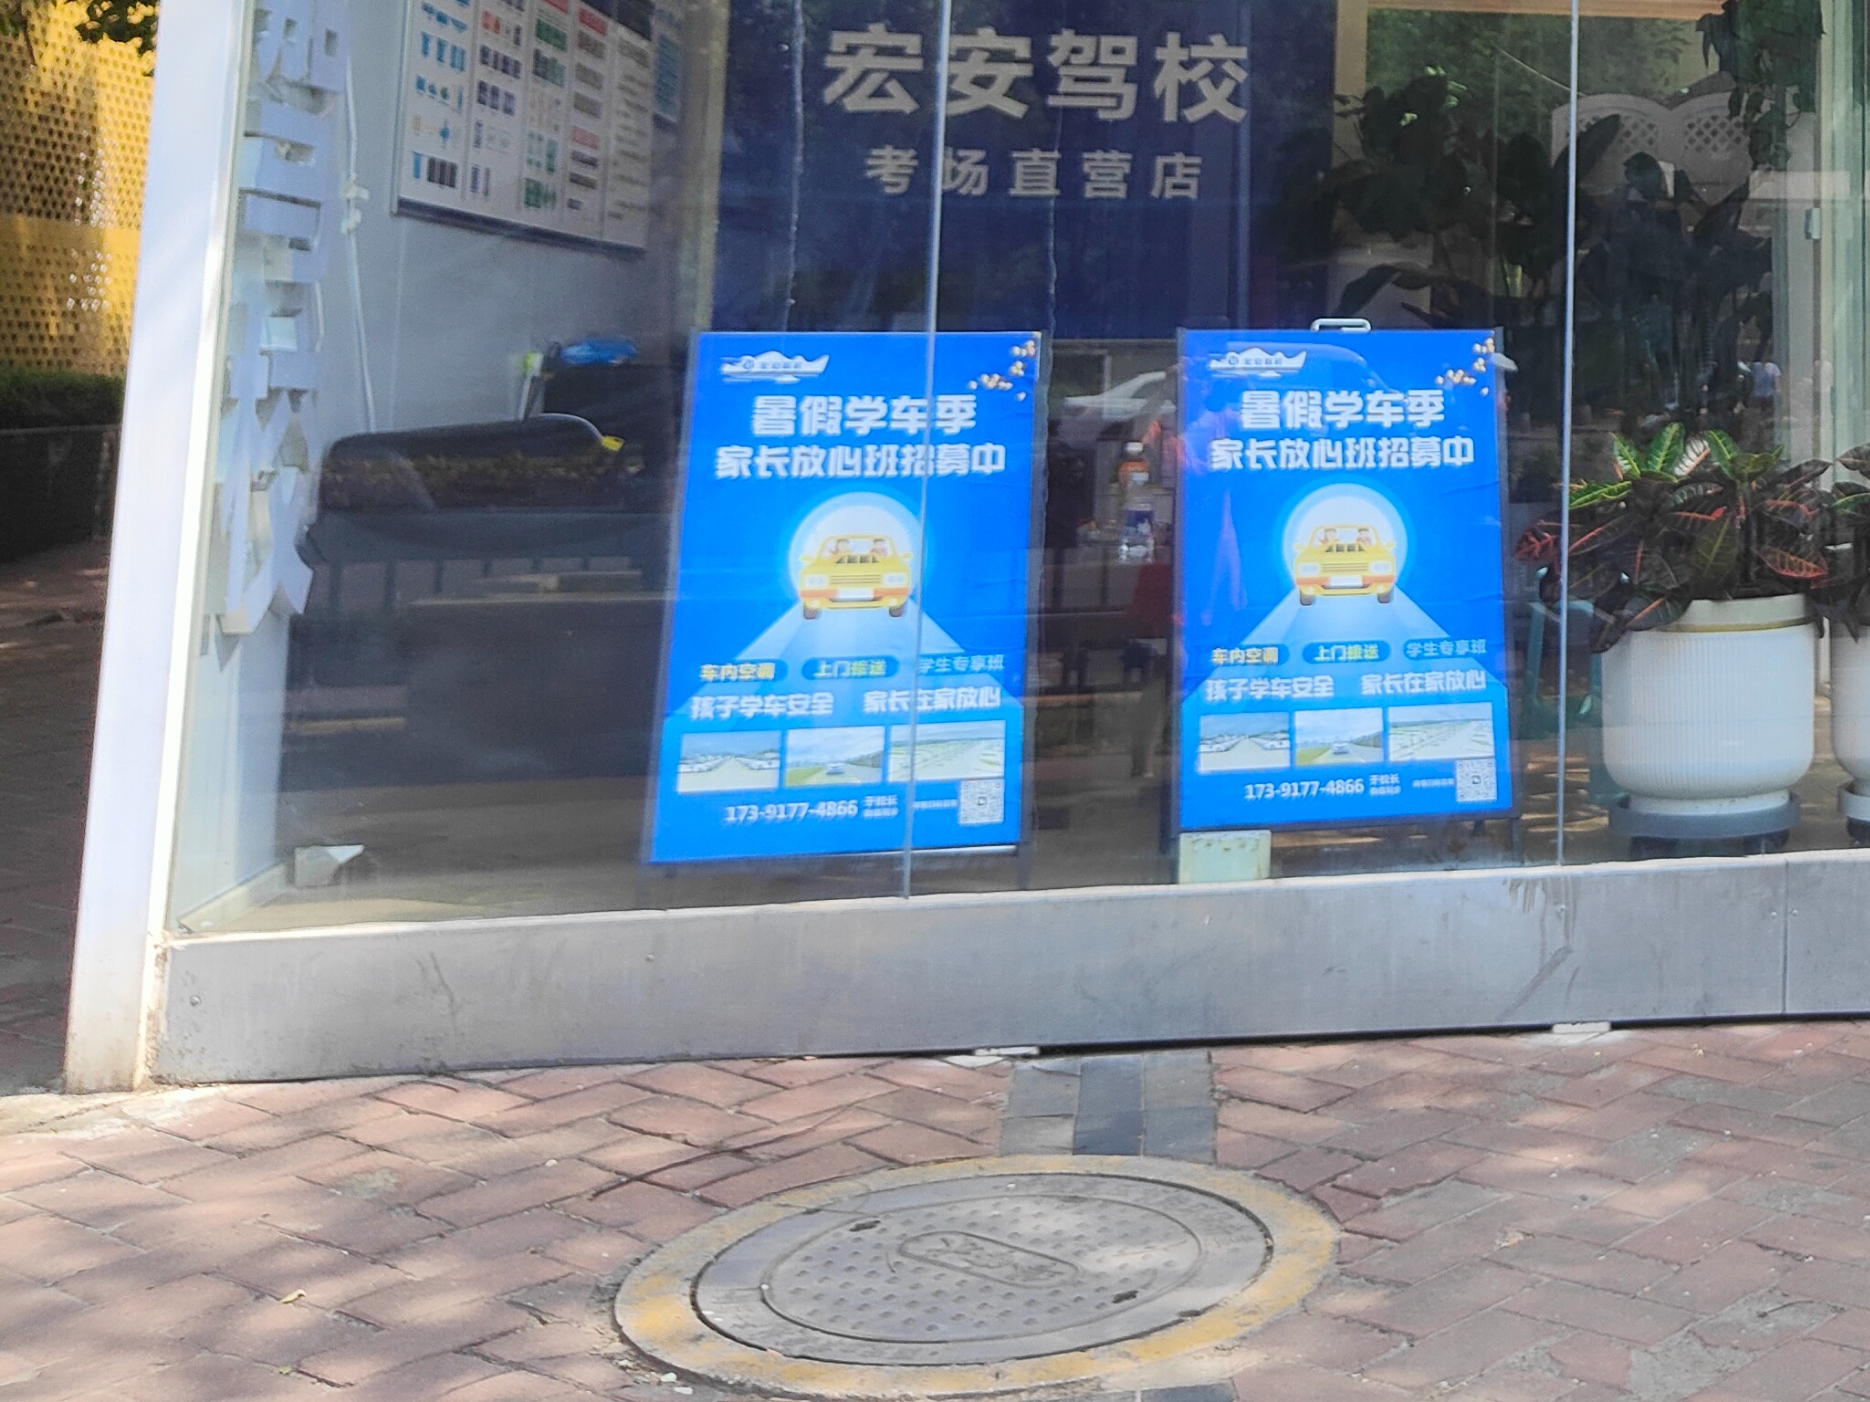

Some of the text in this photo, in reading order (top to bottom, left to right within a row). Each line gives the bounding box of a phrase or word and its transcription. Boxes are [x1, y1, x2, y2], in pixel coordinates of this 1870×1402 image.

[822, 22, 1250, 124] 宏安驾校
[865, 144, 1204, 200] 考场直营店
[751, 394, 978, 438] 暑假学车季
[1240, 389, 1447, 430] 暑假学车季
[714, 442, 1007, 480] 家长放心班招募中
[1208, 436, 1475, 472] 家长放心班招募中
[1361, 669, 1488, 697] 家长在家放心
[1244, 777, 1366, 803] 173-9177-4866
[724, 800, 860, 825] 173-9177-4866
